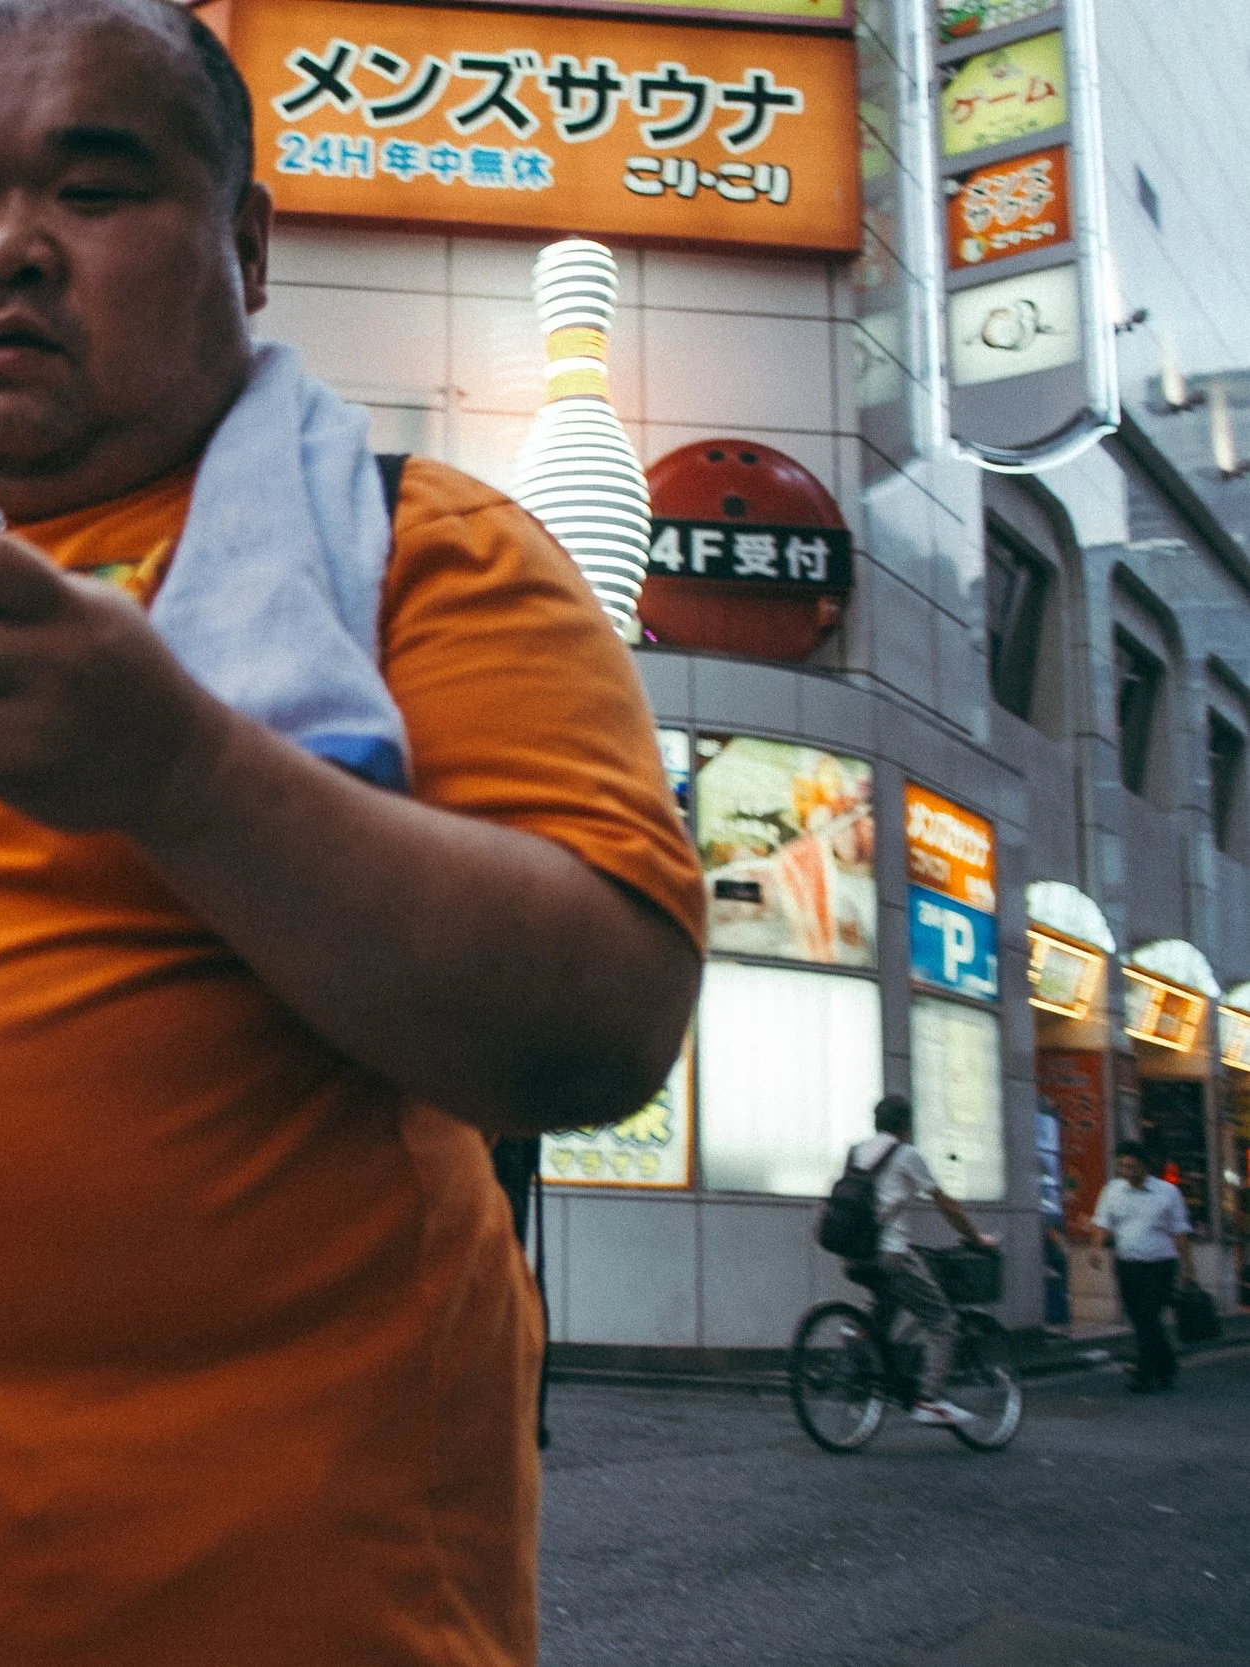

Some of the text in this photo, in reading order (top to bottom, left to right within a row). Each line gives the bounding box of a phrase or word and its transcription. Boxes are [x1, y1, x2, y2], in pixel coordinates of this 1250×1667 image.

[276, 40, 801, 150] メンズサウナ
[650, 526, 831, 581] 4F受付
